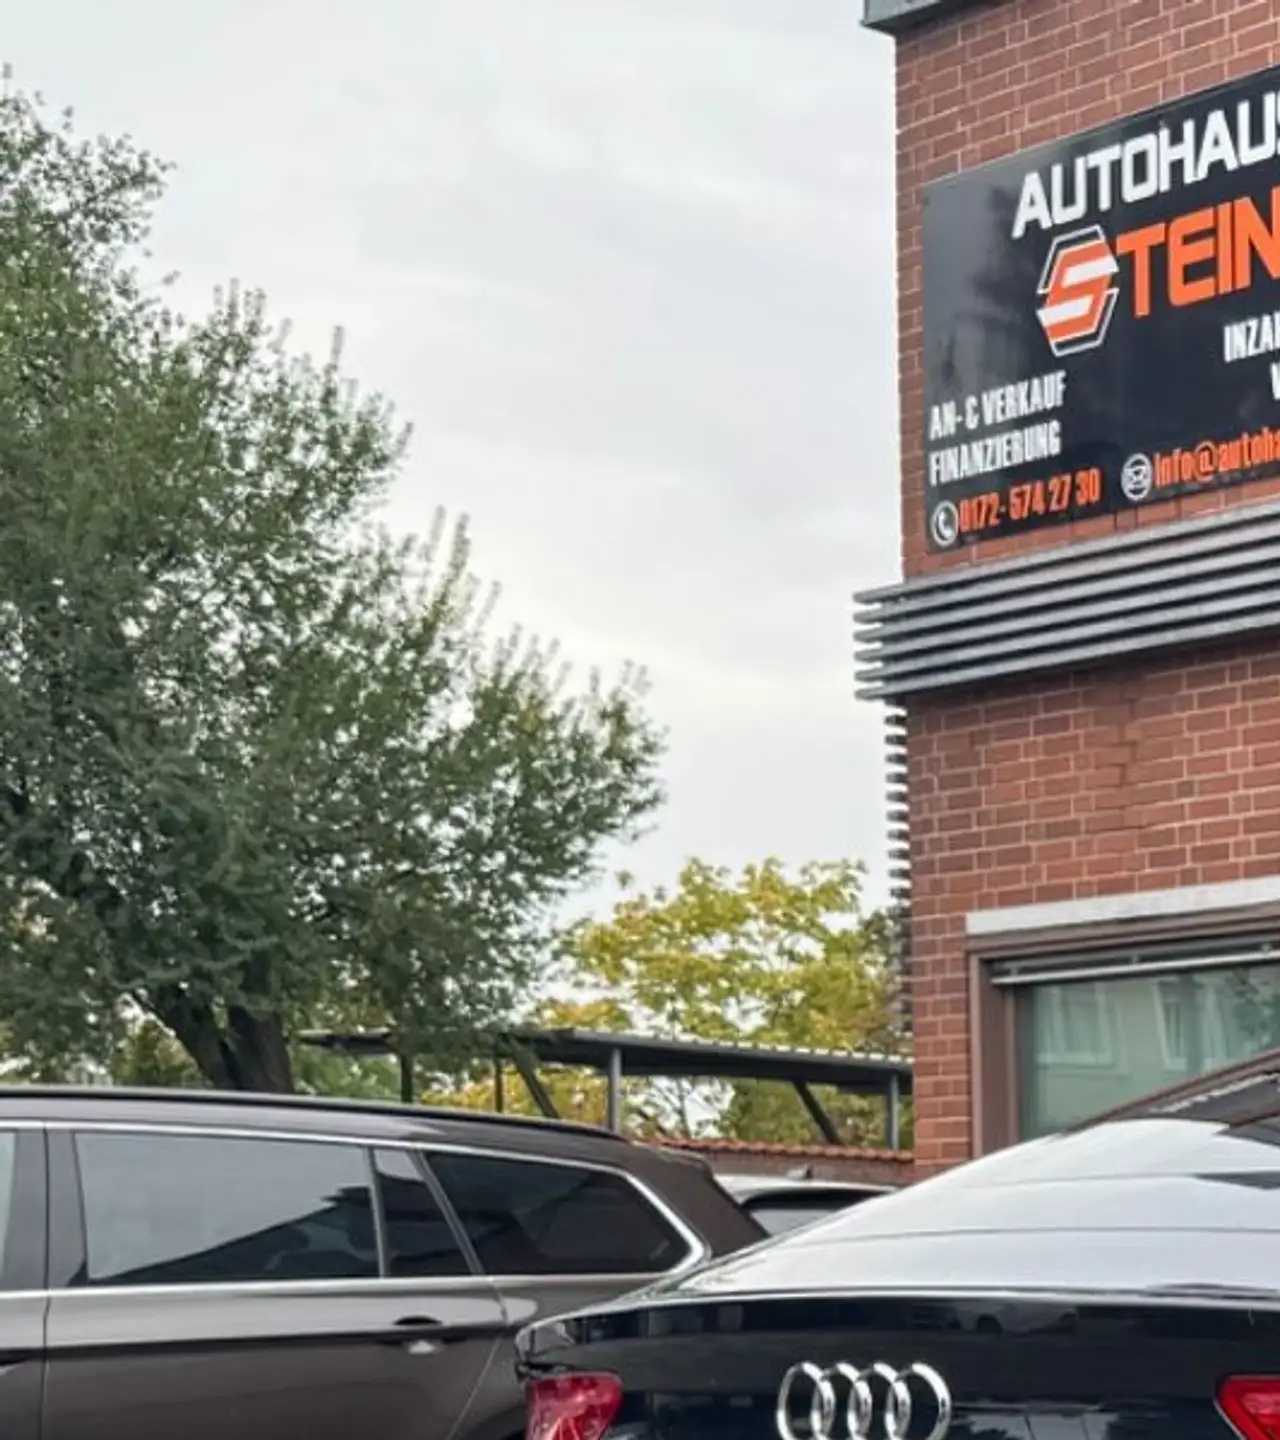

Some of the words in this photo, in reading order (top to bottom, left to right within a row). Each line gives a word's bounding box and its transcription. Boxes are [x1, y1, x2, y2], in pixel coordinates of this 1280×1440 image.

[929, 400, 963, 440] AN-
[982, 369, 1066, 425] VERKAUF
[929, 419, 1061, 487] FINANZIERUNG
[1009, 480, 1045, 520] 574
[1049, 473, 1072, 511] 27
[1076, 467, 1101, 506] 30
